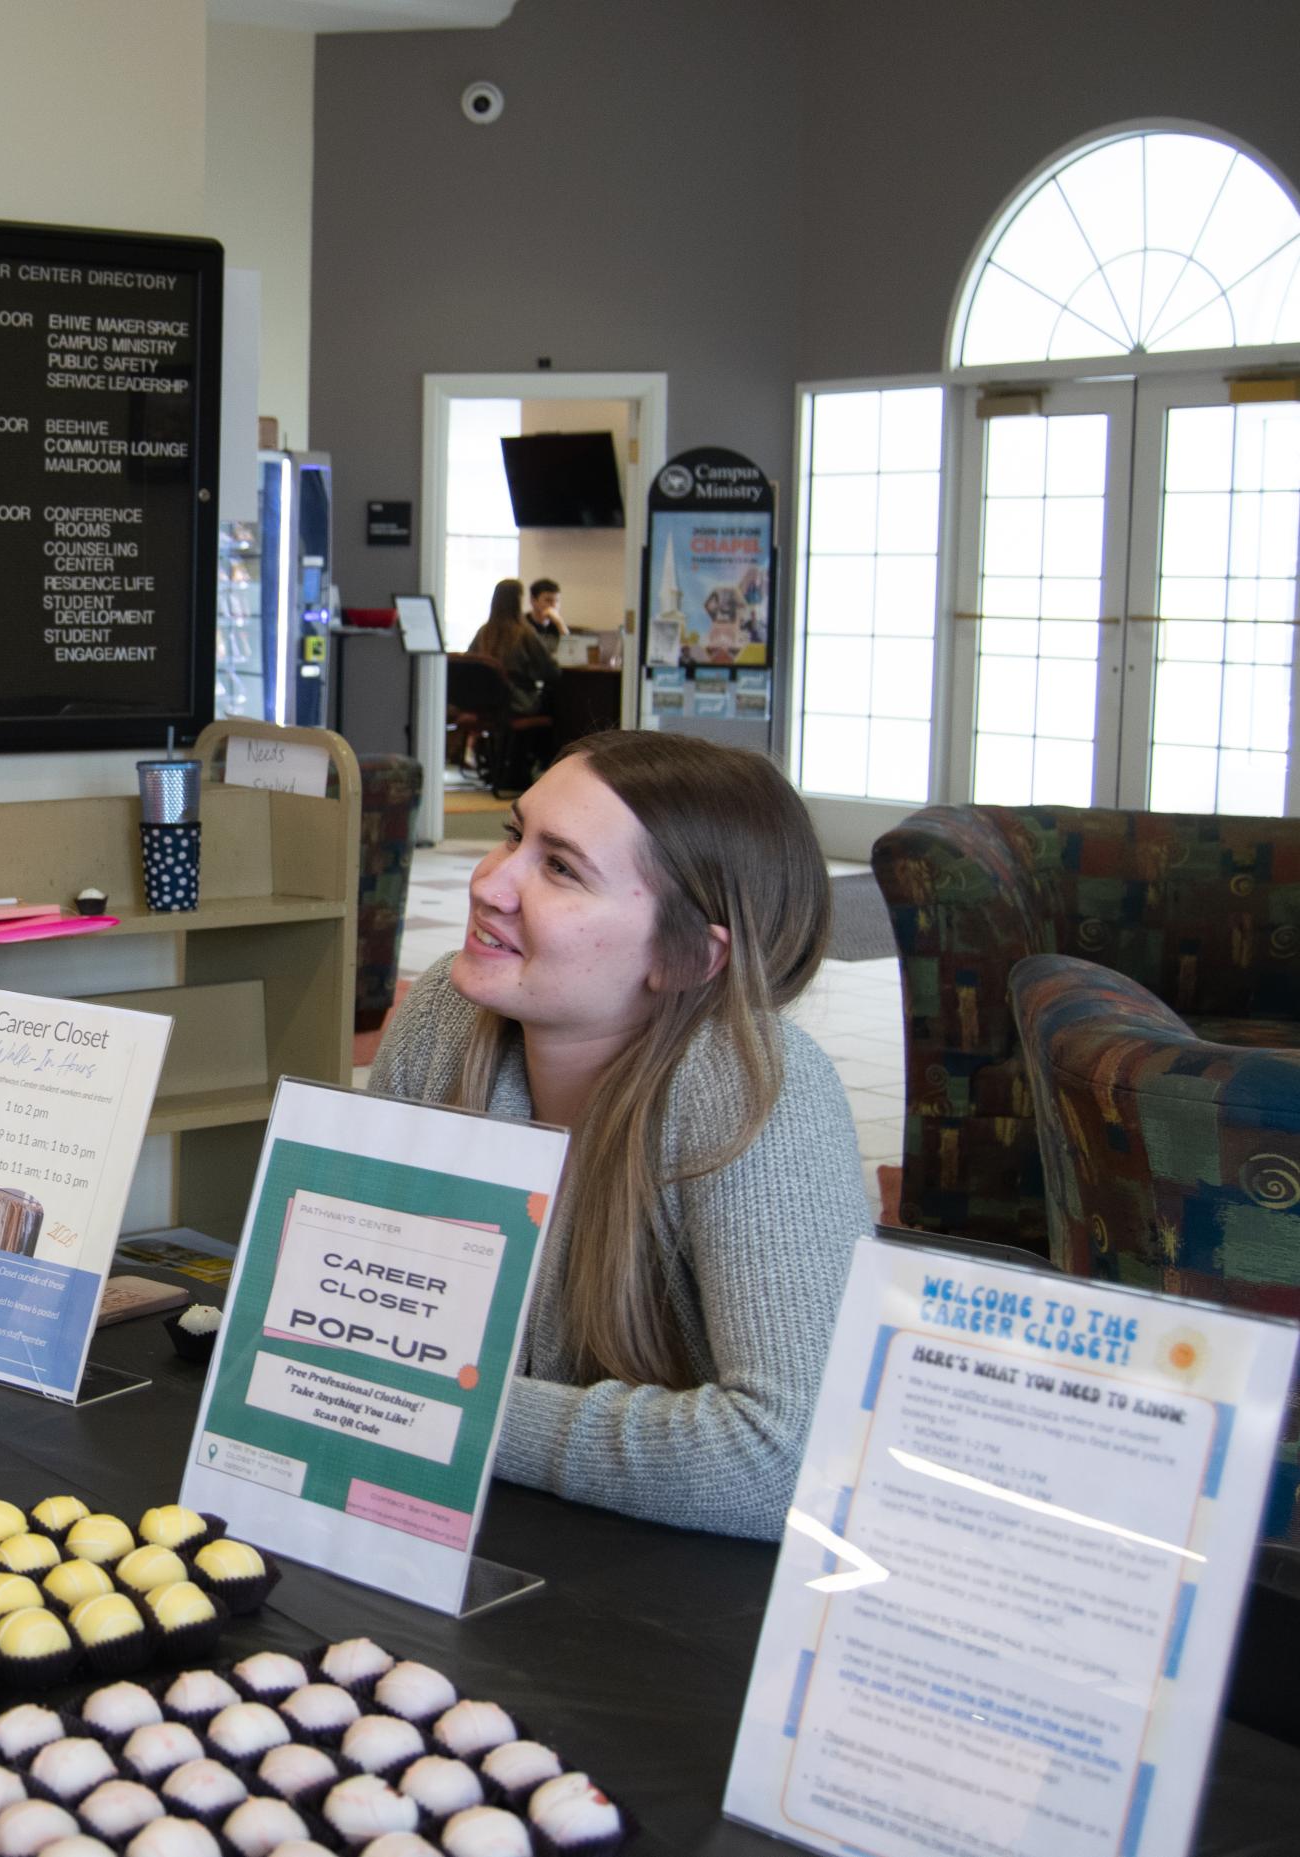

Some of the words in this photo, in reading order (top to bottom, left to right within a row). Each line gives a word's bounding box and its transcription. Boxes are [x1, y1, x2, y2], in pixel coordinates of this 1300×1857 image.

[18, 265, 82, 284] CENTER
[88, 271, 177, 290] DIRECTORY
[48, 314, 92, 331] EHIVE
[47, 334, 108, 351] CAMPUS
[112, 338, 176, 355] MINISTRY
[48, 353, 99, 370] PUBLIC
[103, 356, 158, 373] SAFETY
[46, 372, 106, 390] SERVICE
[108, 376, 189, 394] LEADERSHIP
[45, 418, 109, 436] BEEHIVE
[44, 438, 128, 456] COMMUTER
[131, 440, 188, 458] LOUNGE
[44, 458, 122, 474] MAILROOM
[694, 463, 760, 482] Campus
[696, 483, 763, 502] Ministry
[44, 506, 143, 523] CONFERENCE
[54, 522, 112, 538] ROOMS
[44, 541, 138, 558] COUNSELING
[54, 556, 114, 572] CENTER
[44, 576, 122, 591] RESIDENCE
[124, 576, 154, 591] LIFE
[43, 595, 114, 610] STUDENT
[54, 610, 156, 625] DEVELOPMENT
[44, 628, 112, 644] STUDENT
[54, 646, 156, 662] ENGAGEMENT
[248, 740, 285, 764] Needs
[54, 1020, 110, 1049] Closet
[5, 1101, 12, 1112] 1
[14, 1102, 24, 1114] to
[25, 1104, 33, 1116] 2
[33, 1108, 49, 1120] pm
[6, 1131, 16, 1142] to
[18, 1132, 30, 1146] 11
[31, 1138, 48, 1150] am;
[51, 1140, 58, 1152] 1
[60, 1143, 70, 1154] to
[71, 1144, 80, 1155] 3
[80, 1148, 96, 1160] pm
[12, 1161, 23, 1174] 11
[24, 1167, 42, 1180] am;
[44, 1168, 50, 1180] 1
[52, 1172, 62, 1182] to
[64, 1173, 72, 1184] 3
[72, 1178, 89, 1188] pm
[300, 1204, 356, 1224] PATHWAYS
[358, 1218, 402, 1234] CENTER
[324, 1253, 448, 1294] CAREER
[320, 1279, 439, 1318] CLOSET
[923, 1275, 1033, 1319] WELCOME
[1045, 1300, 1076, 1326] TO
[1087, 1309, 1138, 1344] THE
[289, 1308, 448, 1362] POP-UP
[920, 1300, 1013, 1339] CAREER
[1023, 1323, 1132, 1366] CLOSET!
[285, 1365, 308, 1380] Free
[308, 1372, 374, 1398] Professional
[912, 1344, 968, 1372] HERE'S
[973, 1360, 1020, 1384] WHAT
[1025, 1372, 1054, 1394] YOU
[1059, 1377, 1102, 1404] NEED
[1108, 1390, 1128, 1410] TO
[290, 1384, 314, 1398] Take
[316, 1392, 362, 1414] Anything
[364, 1404, 384, 1418] You
[314, 1408, 338, 1422] Scan
[340, 1416, 354, 1428] QR
[356, 1420, 380, 1435] Code
